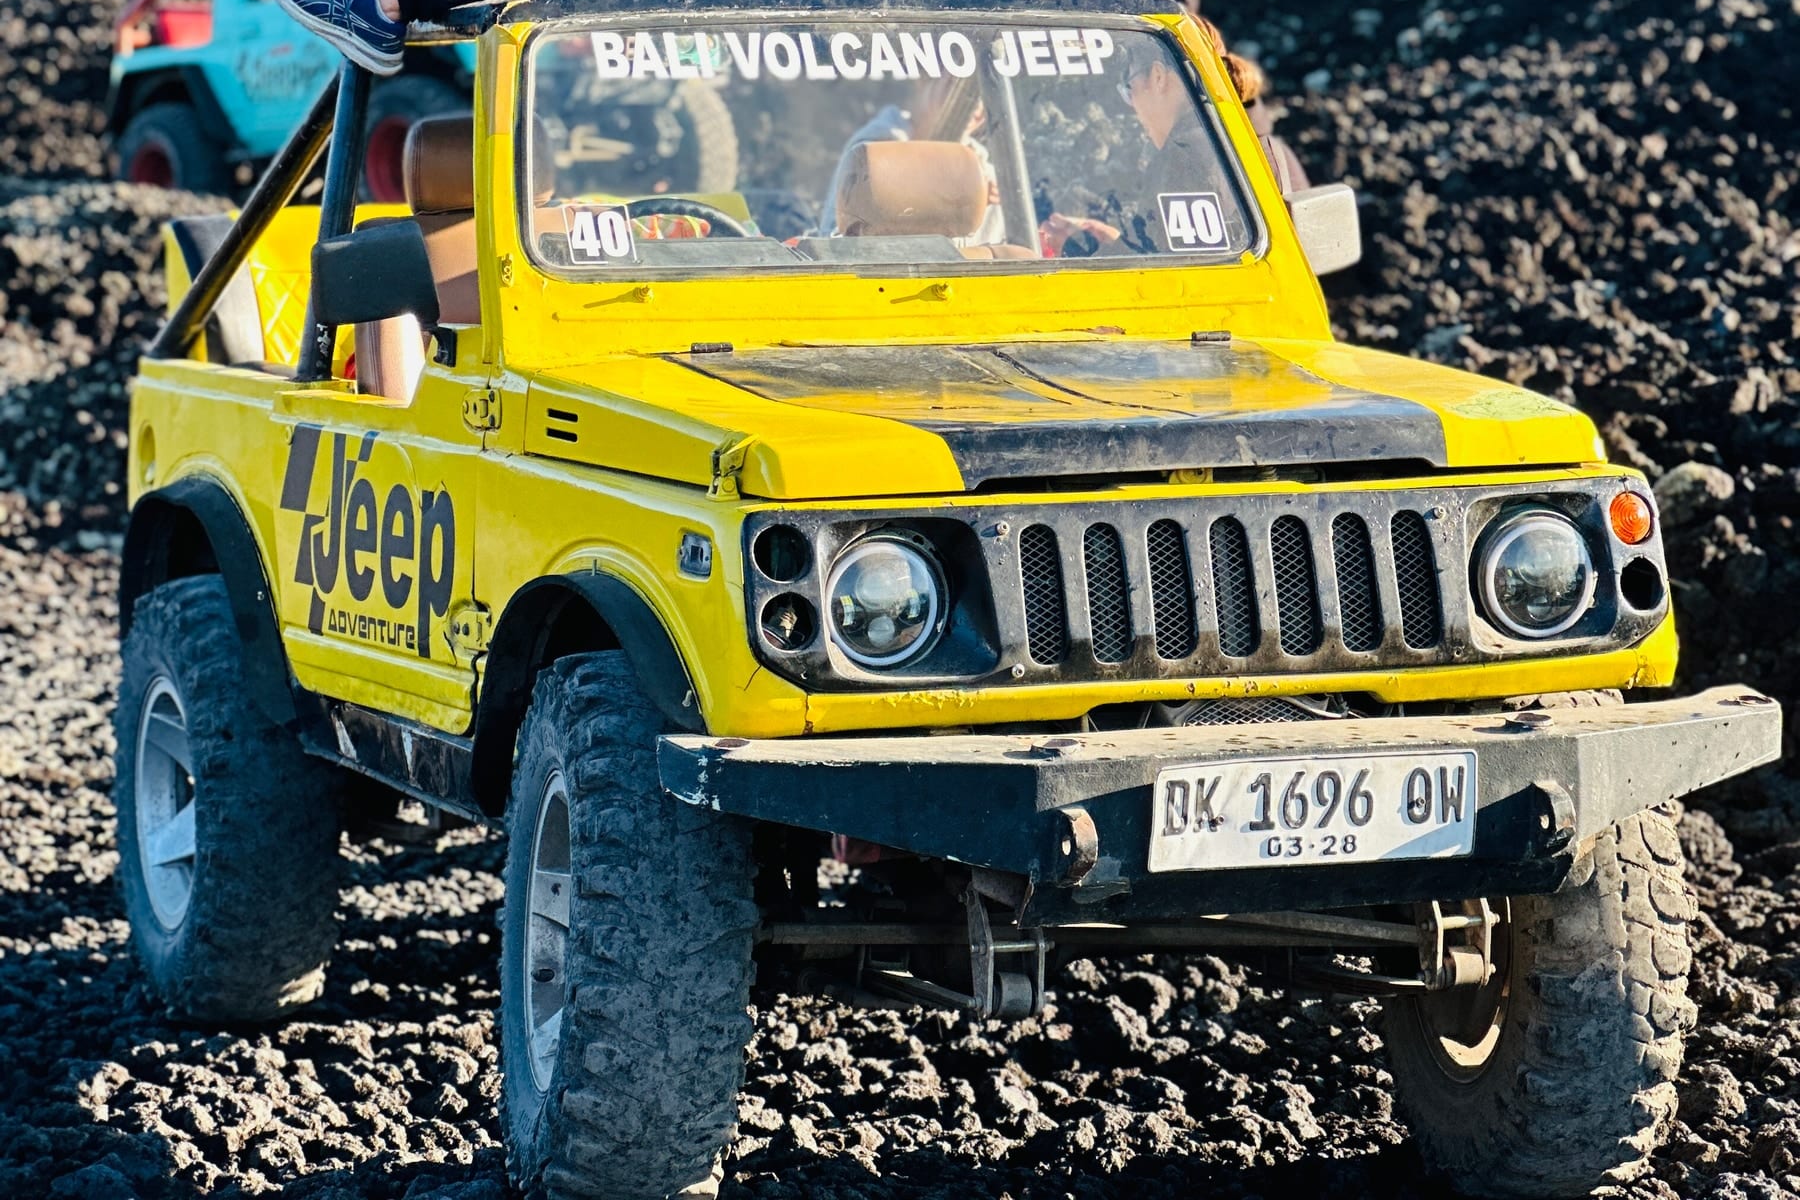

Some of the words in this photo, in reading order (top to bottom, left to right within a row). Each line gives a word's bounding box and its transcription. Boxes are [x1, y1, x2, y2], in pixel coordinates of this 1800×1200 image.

[591, 31, 716, 79] BALI
[724, 31, 977, 80] VOLCANO
[993, 29, 1115, 77] JEEP
[572, 210, 630, 258] 40
[1168, 199, 1223, 245] 40
[312, 432, 456, 659] Jeep
[1162, 775, 1223, 837] DK
[1249, 767, 1374, 832] 1696
